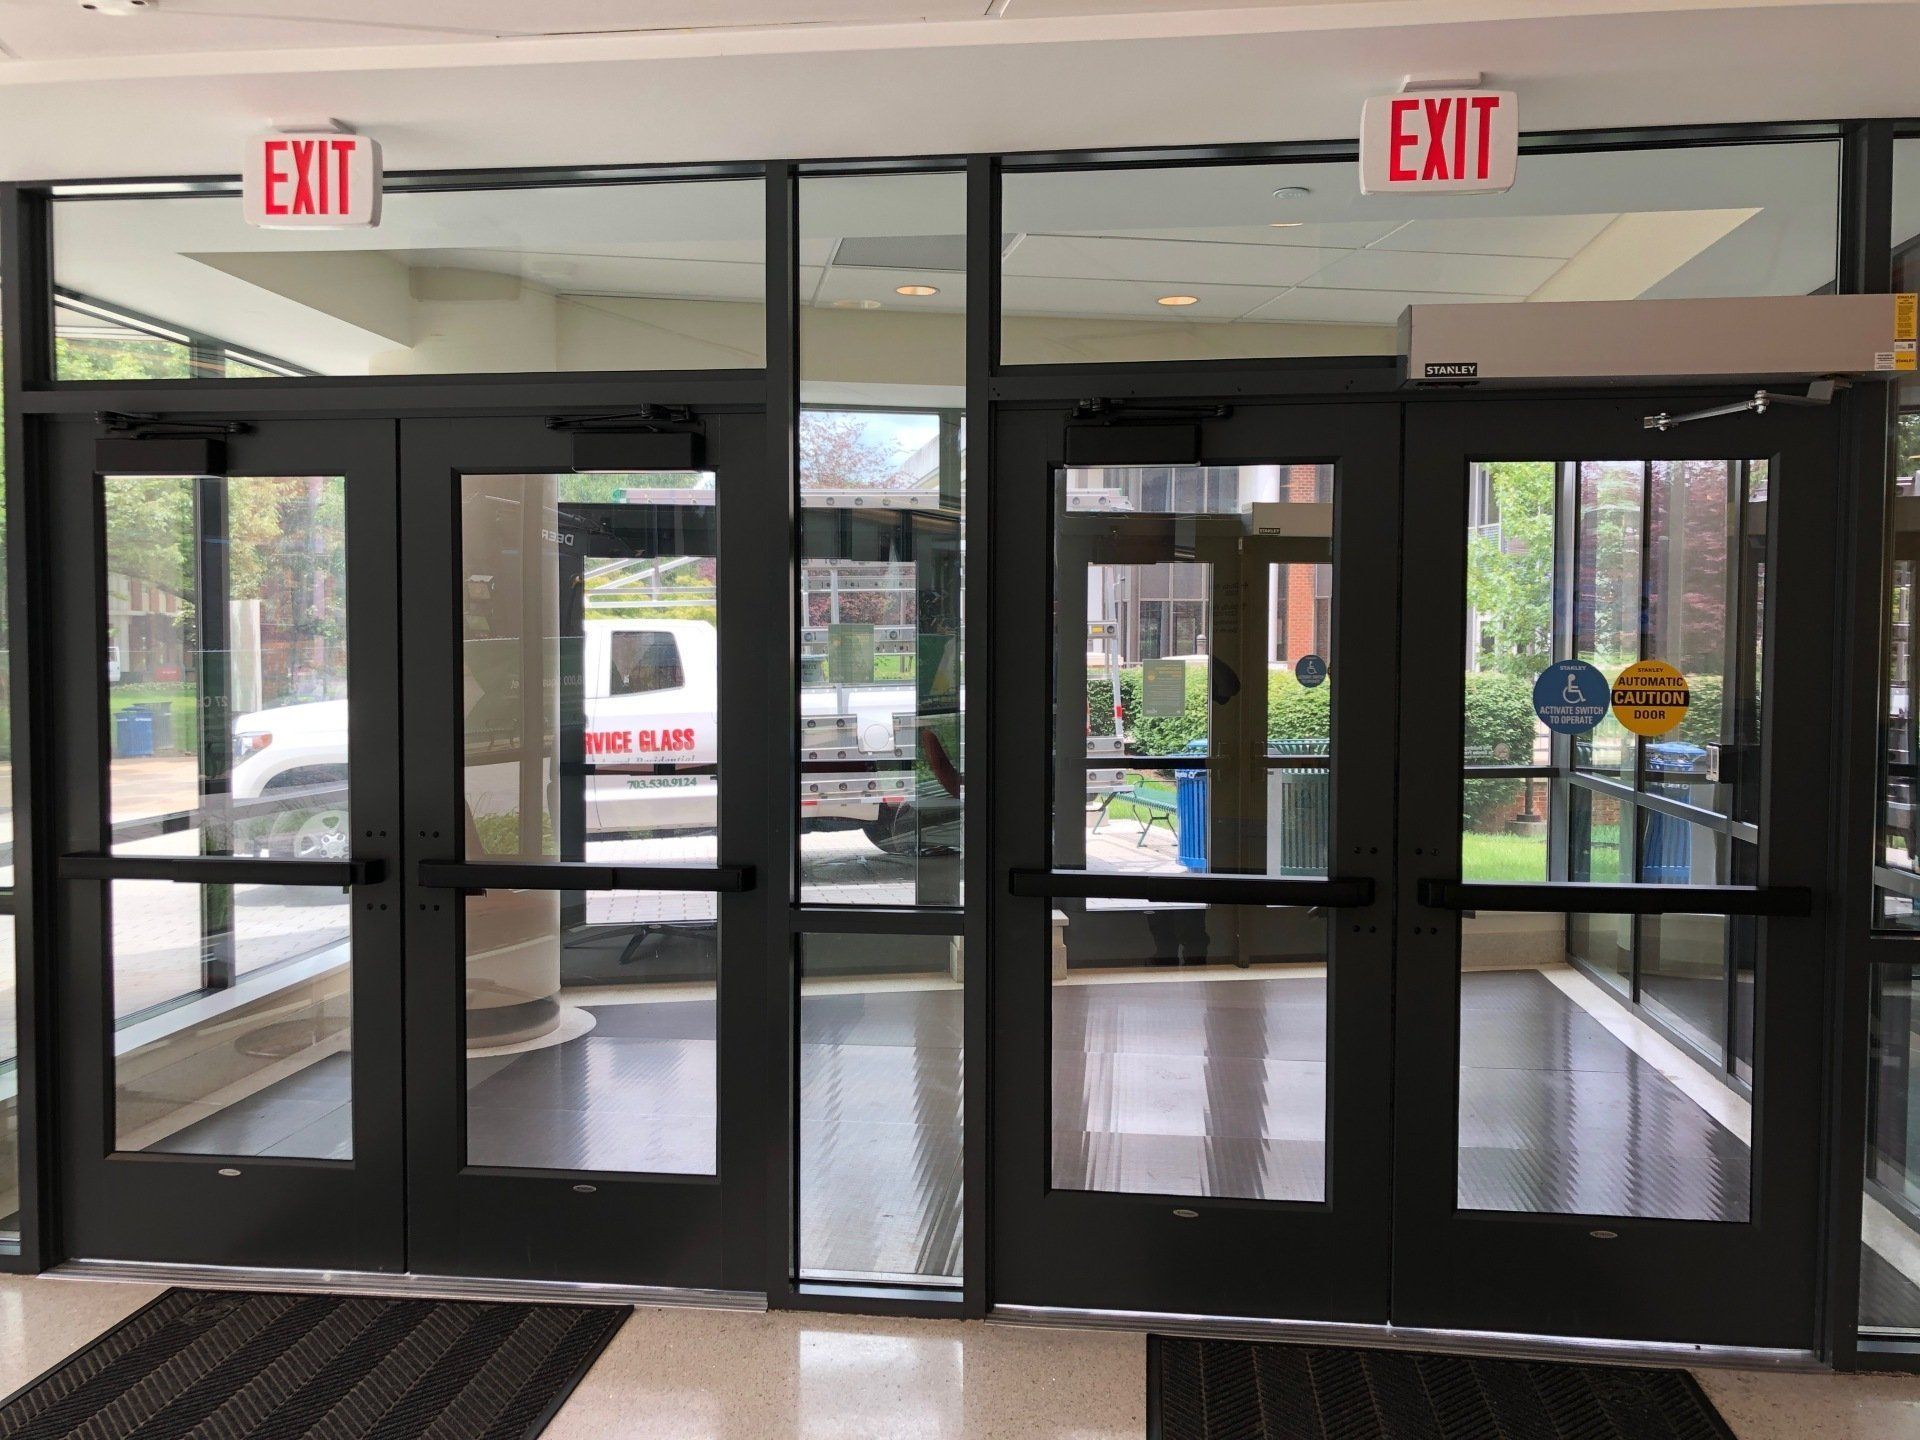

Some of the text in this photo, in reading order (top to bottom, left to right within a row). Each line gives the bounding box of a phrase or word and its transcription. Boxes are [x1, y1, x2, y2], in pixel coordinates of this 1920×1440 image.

[1389, 97, 1500, 181] EXIT
[265, 140, 356, 215] EXIT
[1426, 365, 1476, 375] STANLEY
[1618, 676, 1684, 687] AUTOMATIC
[1614, 691, 1685, 705] CAUTION
[1540, 706, 1604, 715] ACTIVATE SWITCH
[1634, 710, 1666, 720] DOOR
[1550, 716, 1593, 725] TO OPERATE
[584, 728, 695, 755] RVICE GLASS
[627, 777, 698, 789] 703.530.9124
